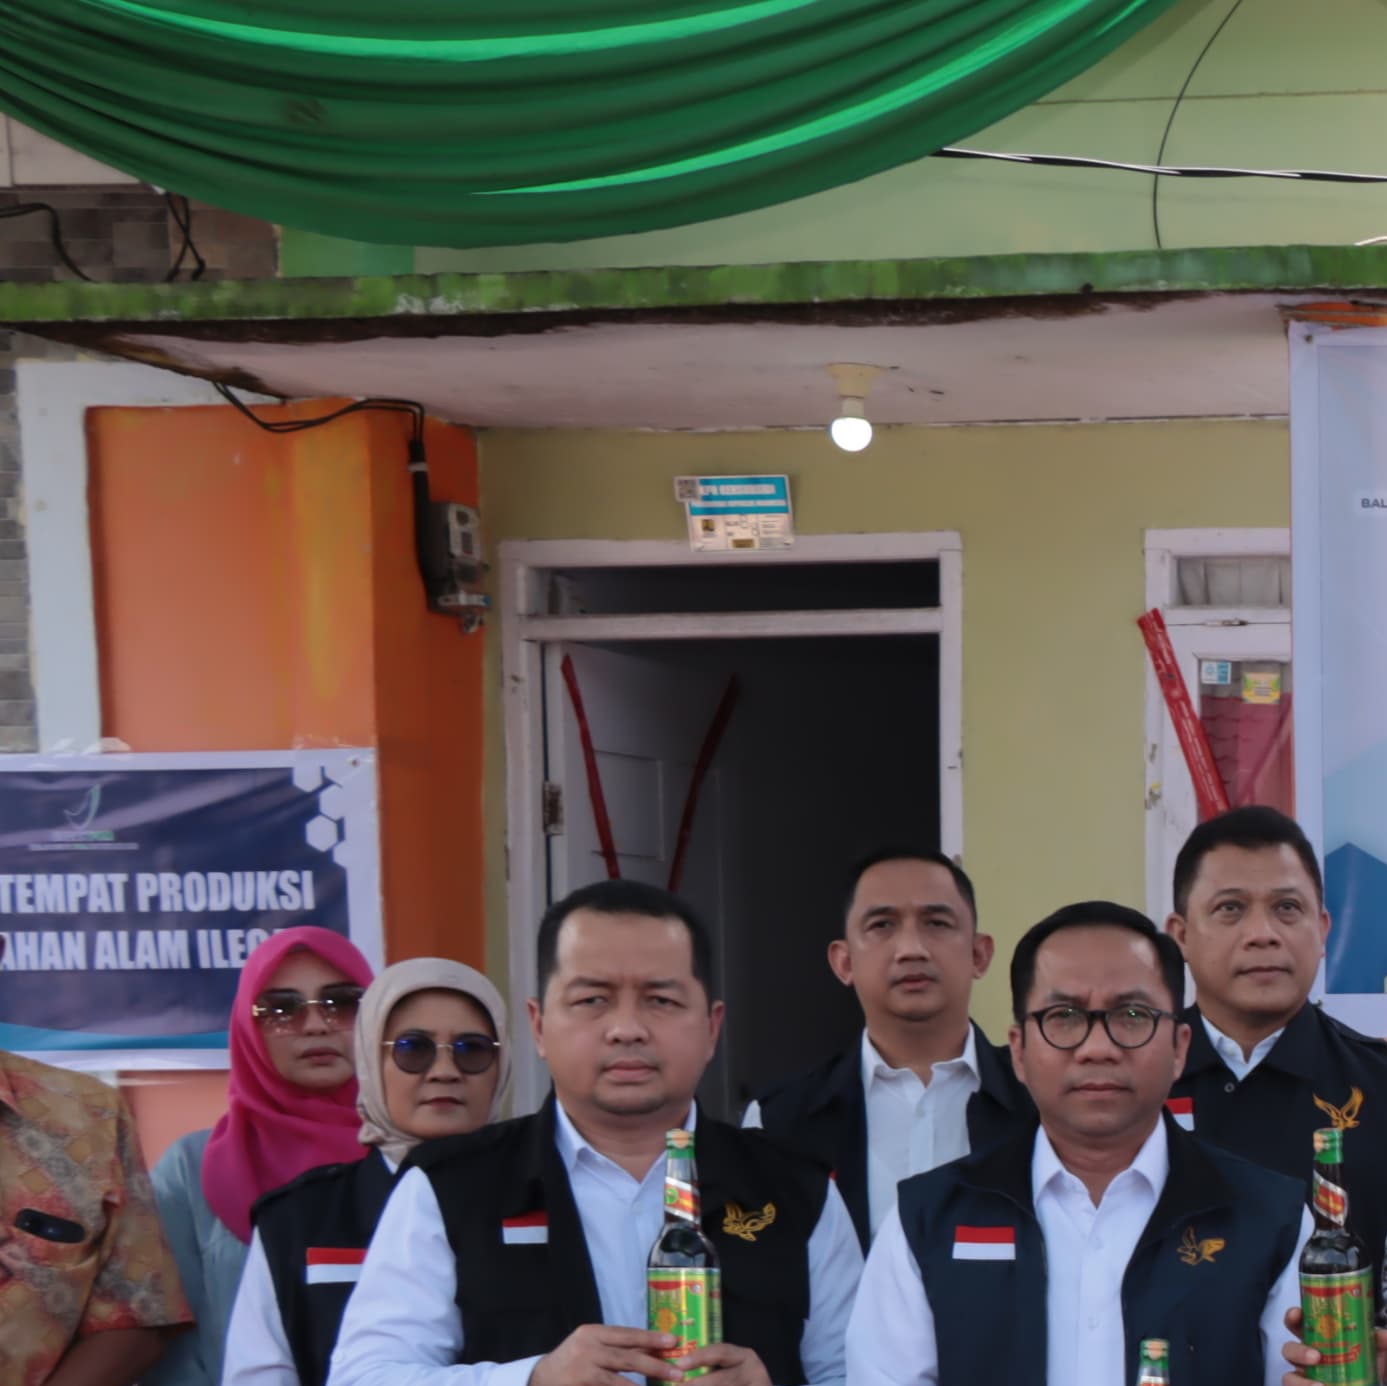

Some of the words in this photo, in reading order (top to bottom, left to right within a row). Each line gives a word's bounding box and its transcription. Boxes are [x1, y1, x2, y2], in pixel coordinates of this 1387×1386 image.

[0, 873, 129, 914] TEMPAT
[136, 870, 316, 913] PRODUKSI
[0, 930, 88, 970] AHAN
[94, 930, 190, 970] ALAM
